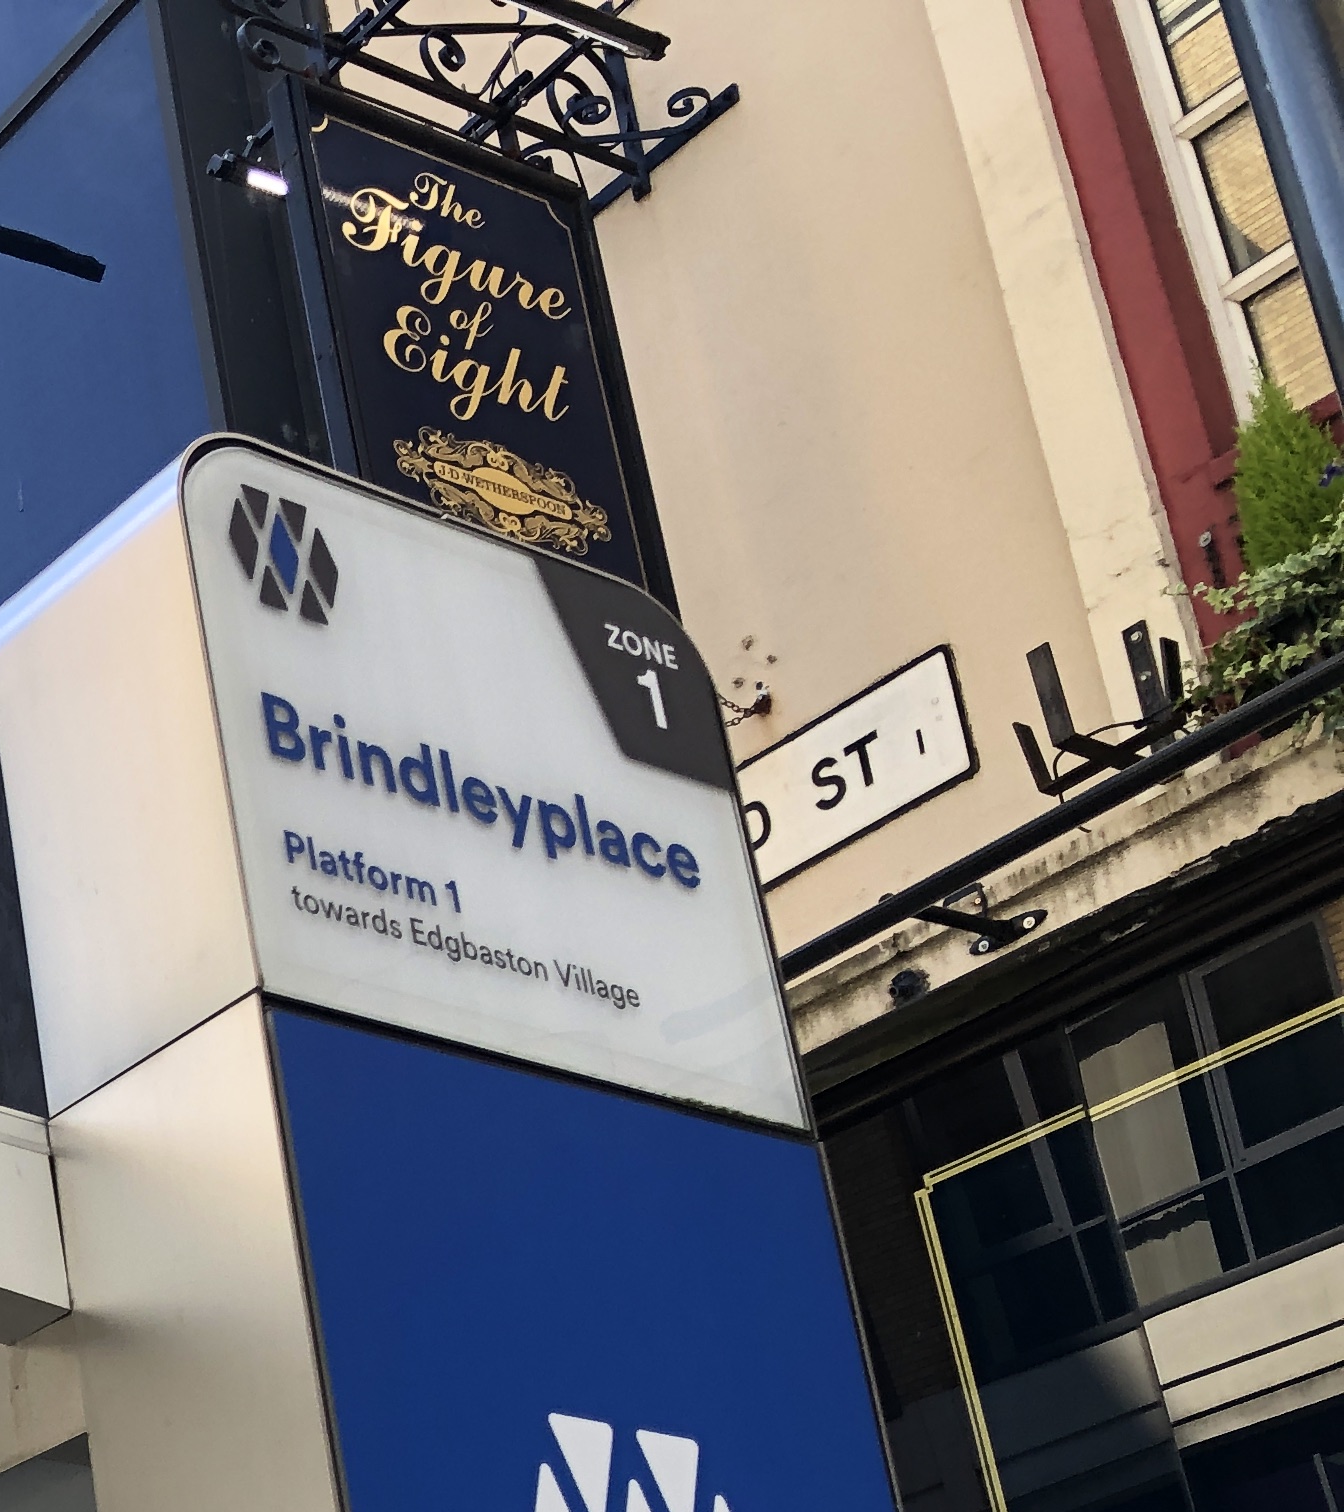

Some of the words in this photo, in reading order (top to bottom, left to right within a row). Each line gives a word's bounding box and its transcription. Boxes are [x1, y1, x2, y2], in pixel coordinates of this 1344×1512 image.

[408, 171, 485, 229] The
[341, 187, 571, 323] Figure
[384, 305, 570, 423] Eight
[449, 302, 494, 351] of
[603, 624, 678, 670] ZONE
[637, 669, 667, 729] 1
[260, 690, 700, 888] Brindleyplace
[812, 731, 878, 811] ST
[283, 830, 437, 908] Platform
[445, 879, 462, 913] 1
[291, 885, 403, 941] towards
[411, 919, 548, 981] Edgbaston
[553, 958, 640, 1008] Village
